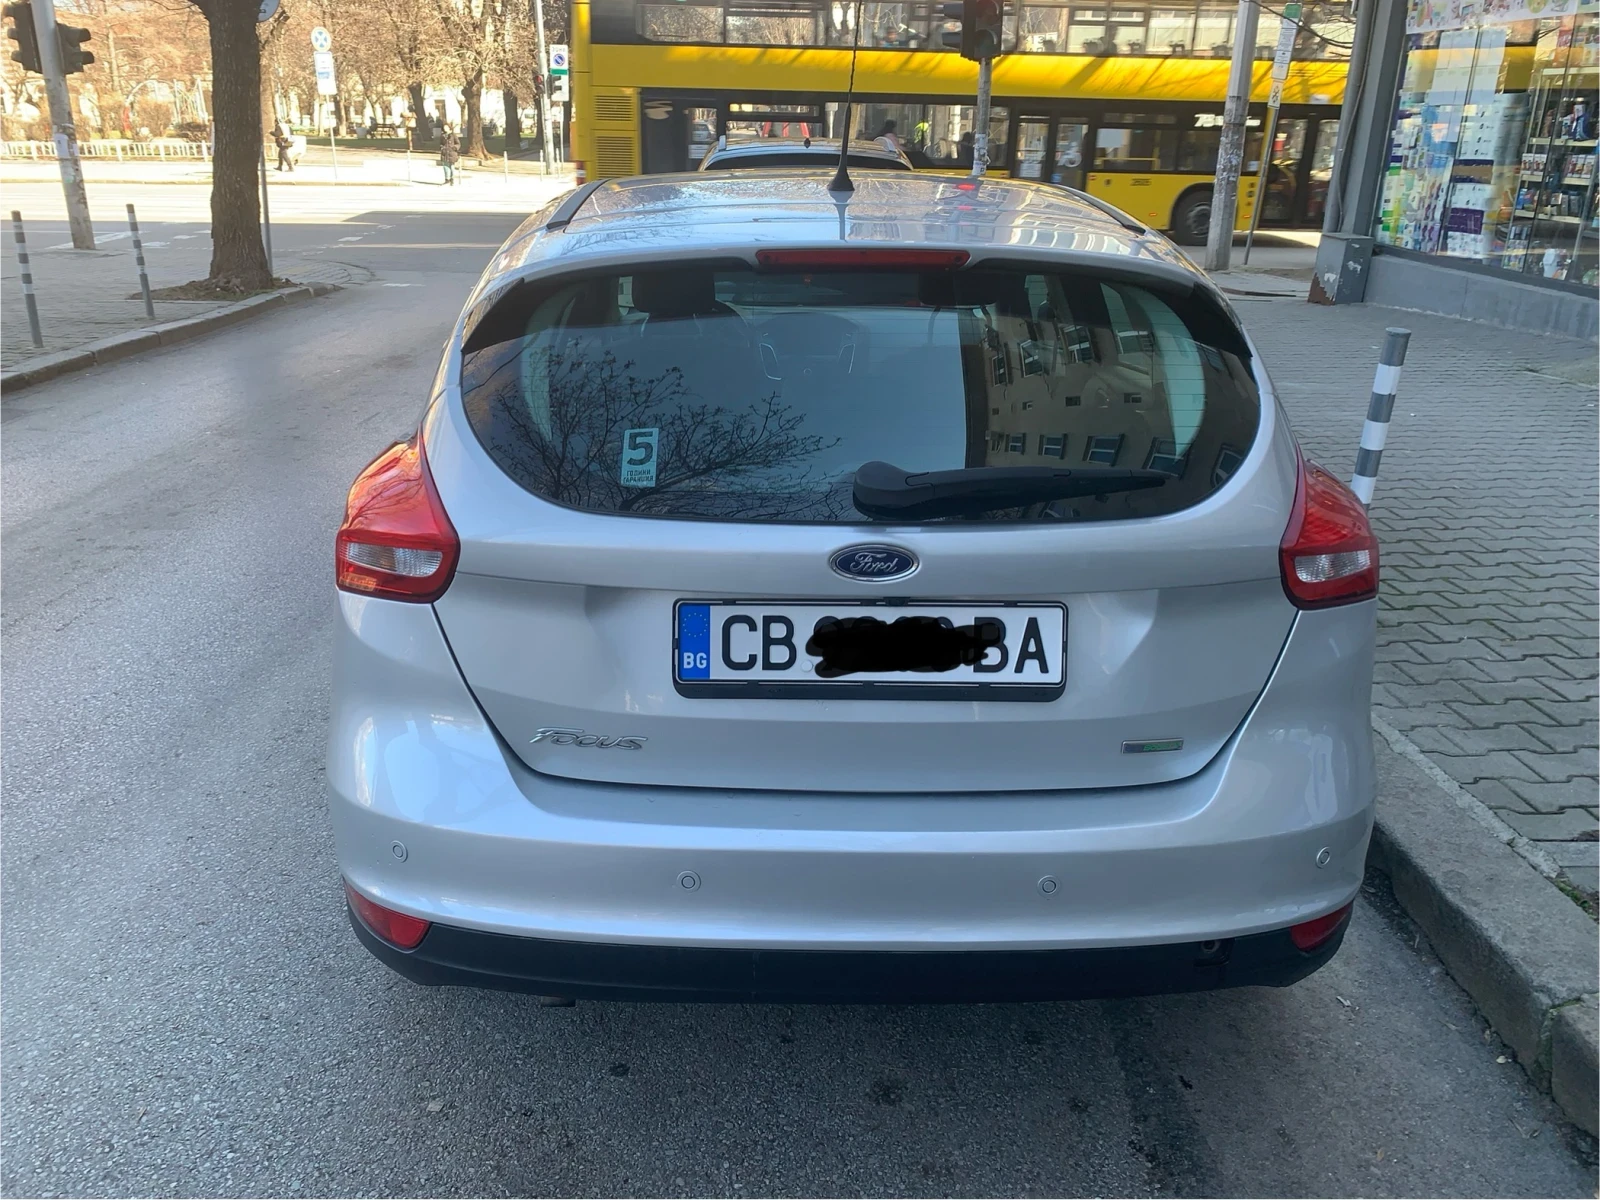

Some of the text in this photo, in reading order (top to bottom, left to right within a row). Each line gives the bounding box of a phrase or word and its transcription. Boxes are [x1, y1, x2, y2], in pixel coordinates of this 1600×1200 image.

[627, 431, 654, 466] 5
[849, 552, 899, 573] Ford
[721, 614, 797, 671] CB
[683, 652, 708, 669] BG
